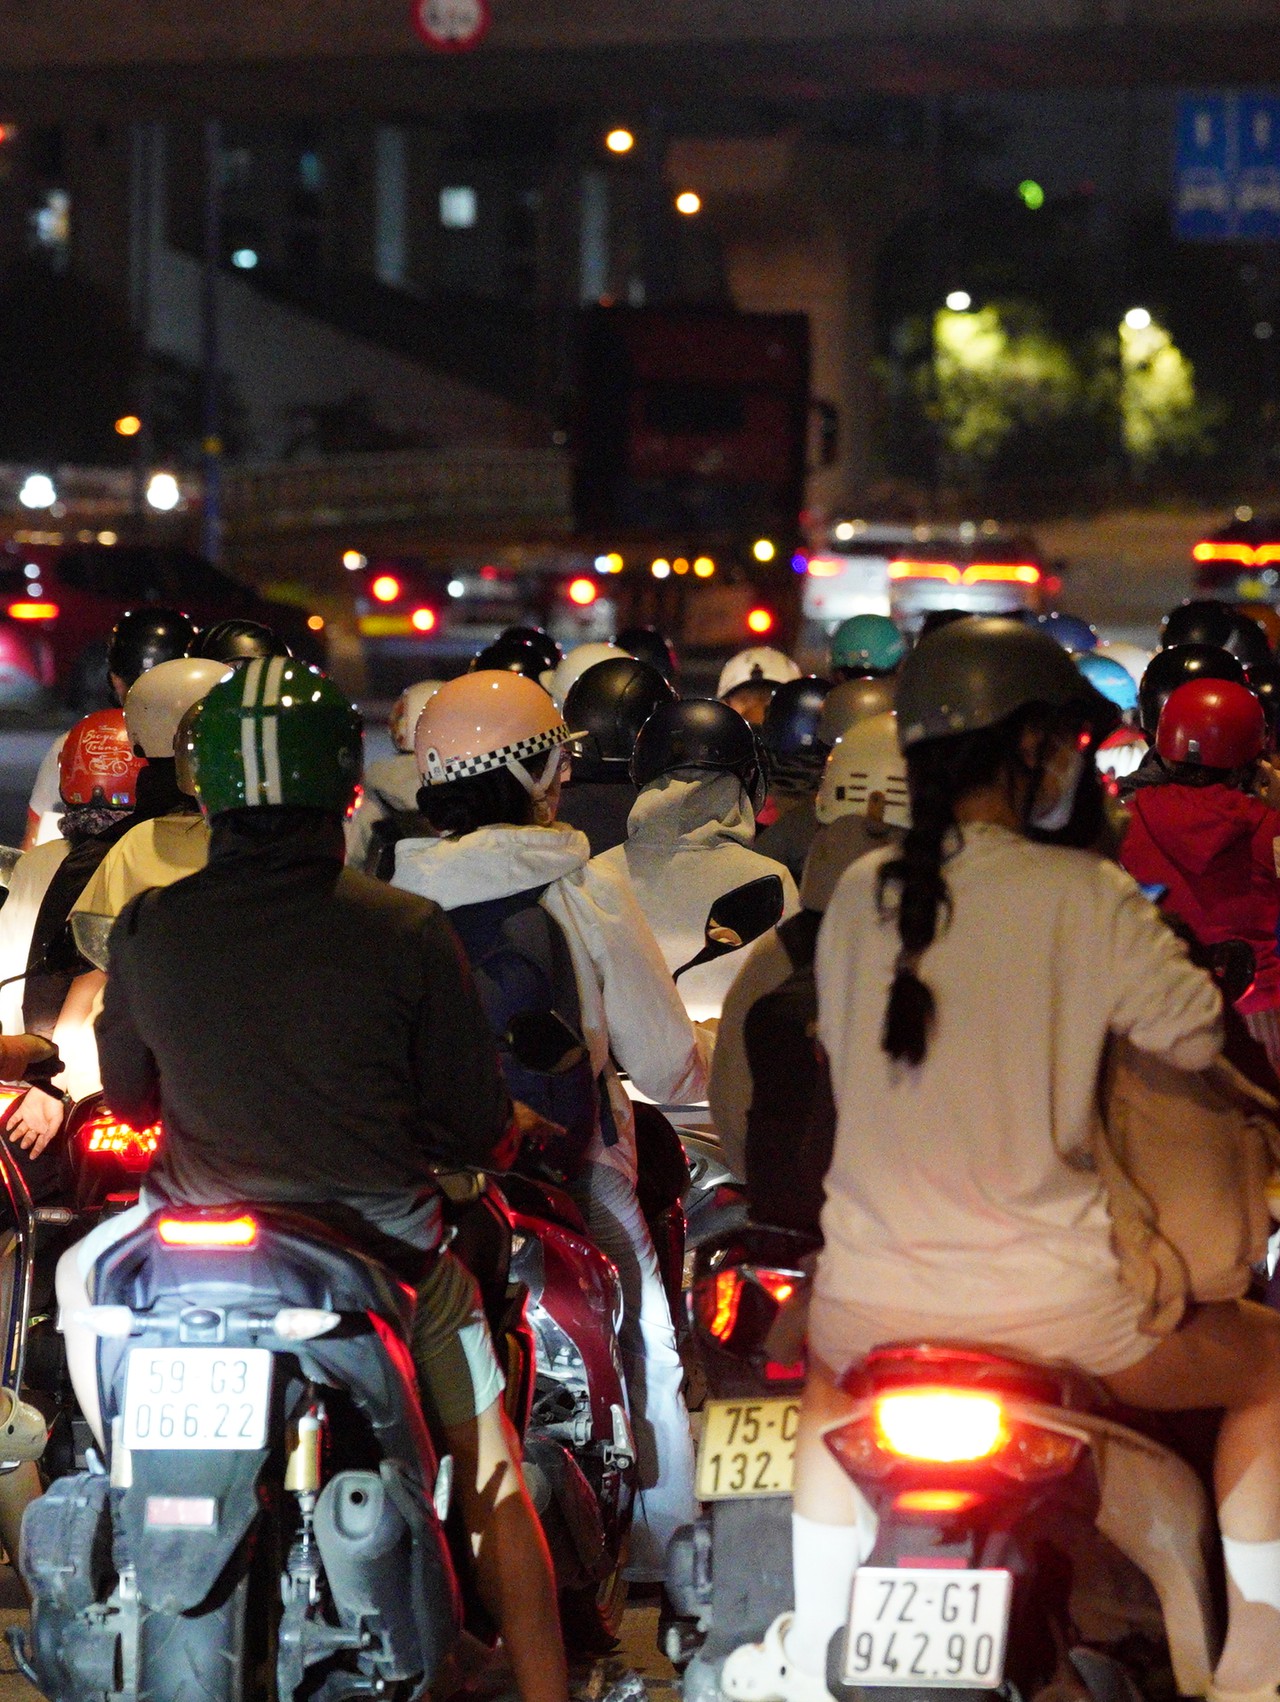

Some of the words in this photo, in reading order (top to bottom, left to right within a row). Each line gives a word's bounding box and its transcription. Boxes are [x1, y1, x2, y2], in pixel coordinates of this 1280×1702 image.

[136, 1403, 254, 1439] 066.22
[710, 1451, 795, 1492] 132.
[876, 1580, 981, 1624] 72-G1
[853, 1631, 994, 1676] 942.90
